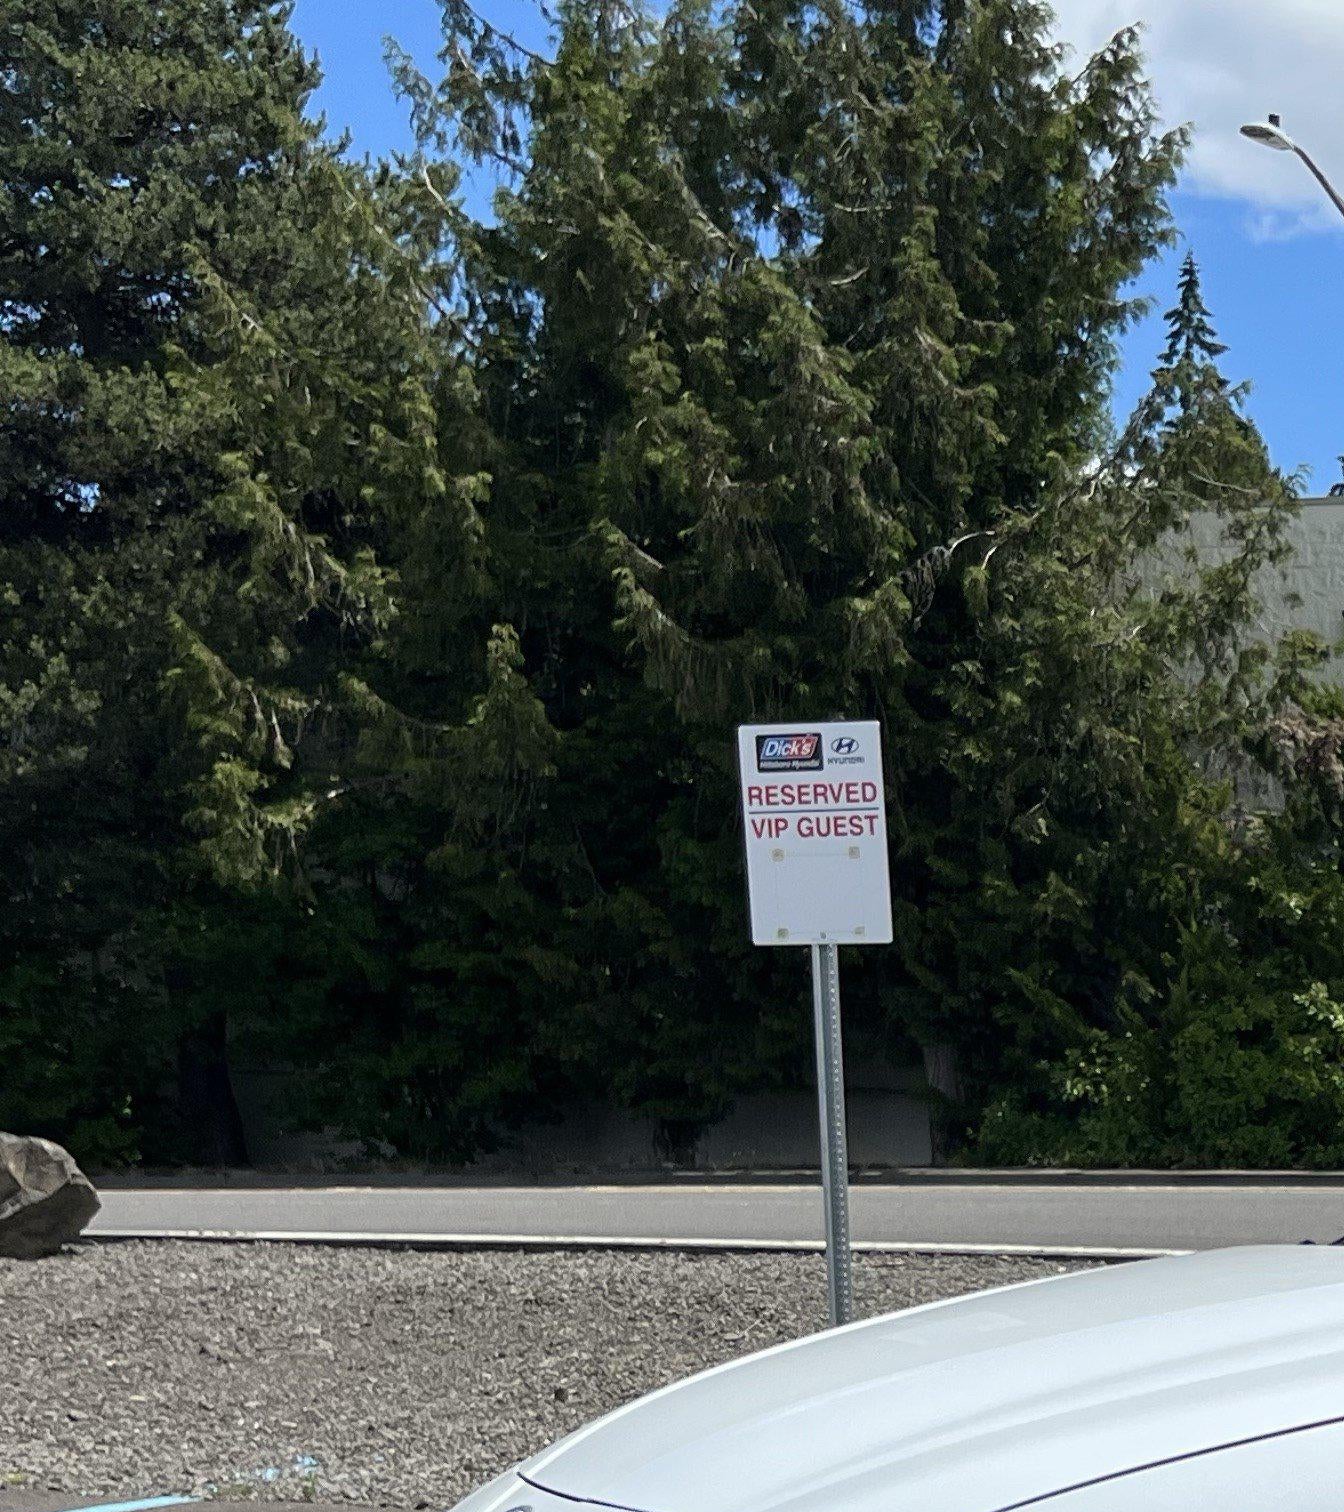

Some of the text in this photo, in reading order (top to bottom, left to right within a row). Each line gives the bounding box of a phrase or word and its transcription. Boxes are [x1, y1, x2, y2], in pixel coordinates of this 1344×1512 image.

[747, 781, 878, 807] RESERVED
[751, 814, 879, 839] VIP GUEST
